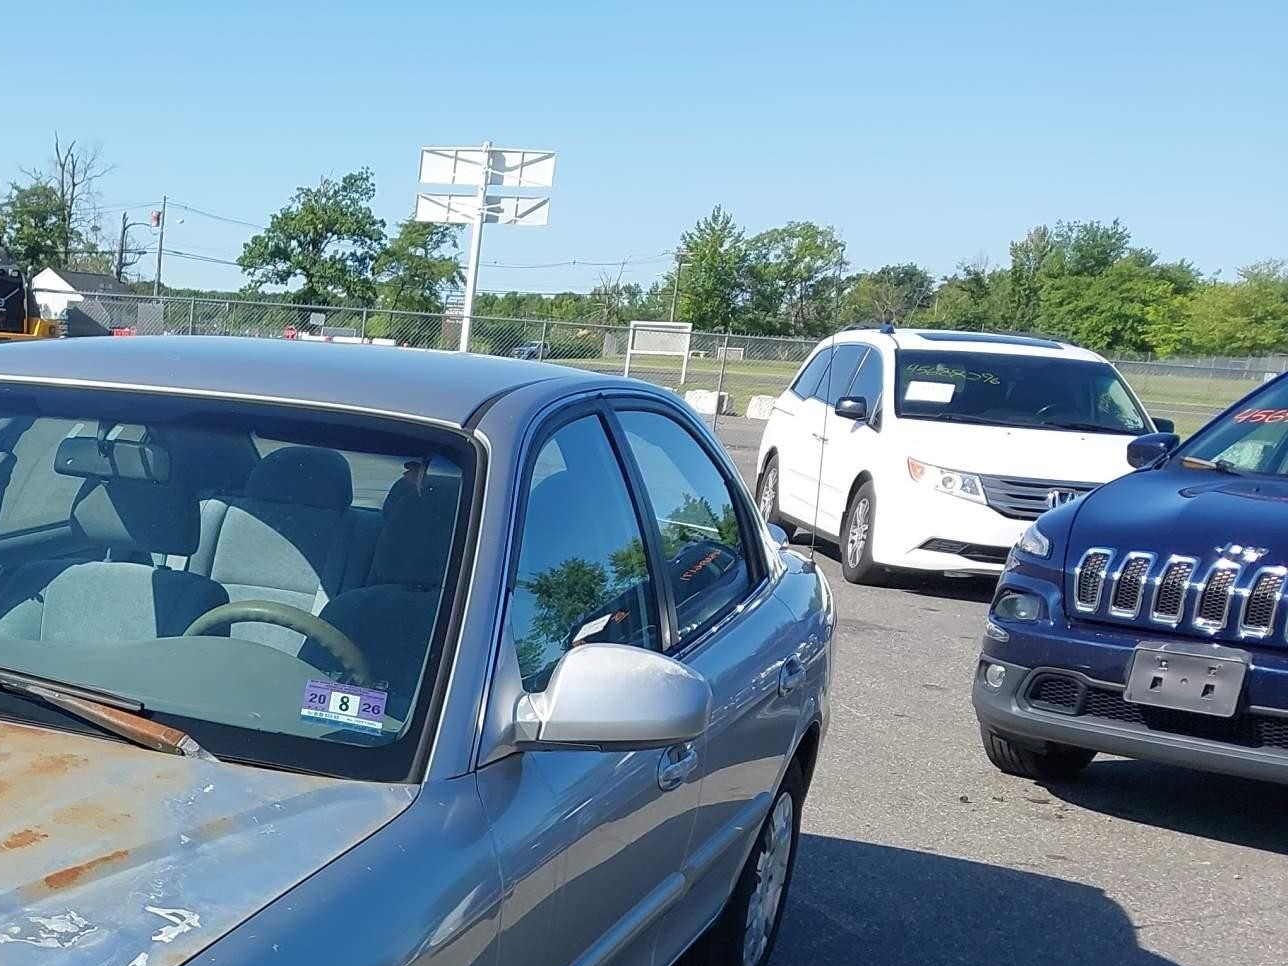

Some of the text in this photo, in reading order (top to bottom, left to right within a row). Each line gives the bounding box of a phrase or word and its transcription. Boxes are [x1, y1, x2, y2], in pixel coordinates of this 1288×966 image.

[1234, 408, 1288, 423] 456
[308, 693, 327, 705] 20
[338, 696, 350, 712] 8
[362, 703, 381, 715] 26
